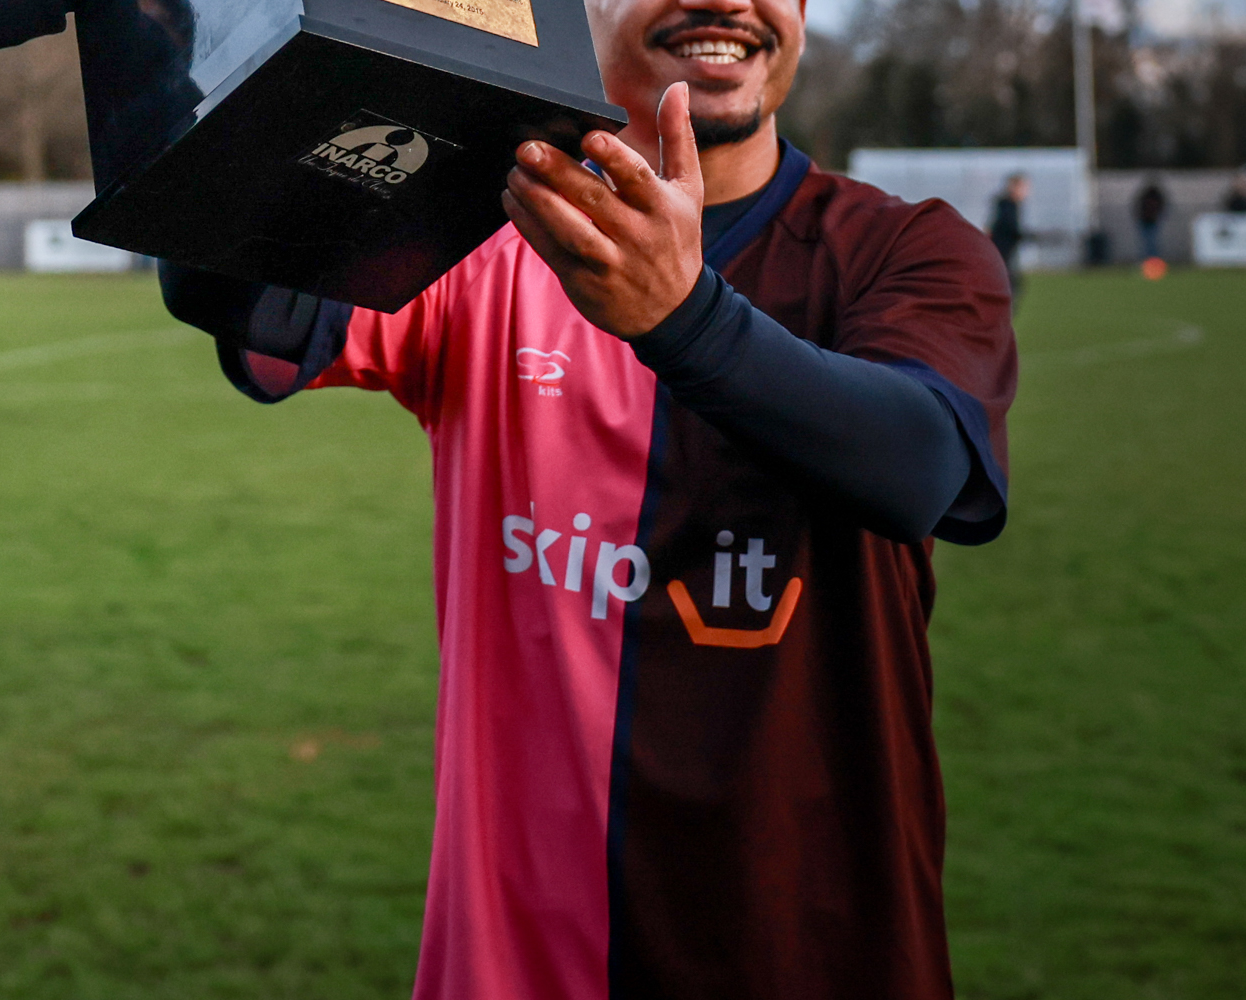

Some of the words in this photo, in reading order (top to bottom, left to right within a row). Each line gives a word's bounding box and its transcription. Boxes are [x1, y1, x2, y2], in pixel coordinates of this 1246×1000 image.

[454, 0, 465, 10] 24,
[311, 142, 407, 184] INARCO
[538, 385, 563, 396] kits
[502, 501, 651, 620] skip
[712, 530, 776, 612] it
